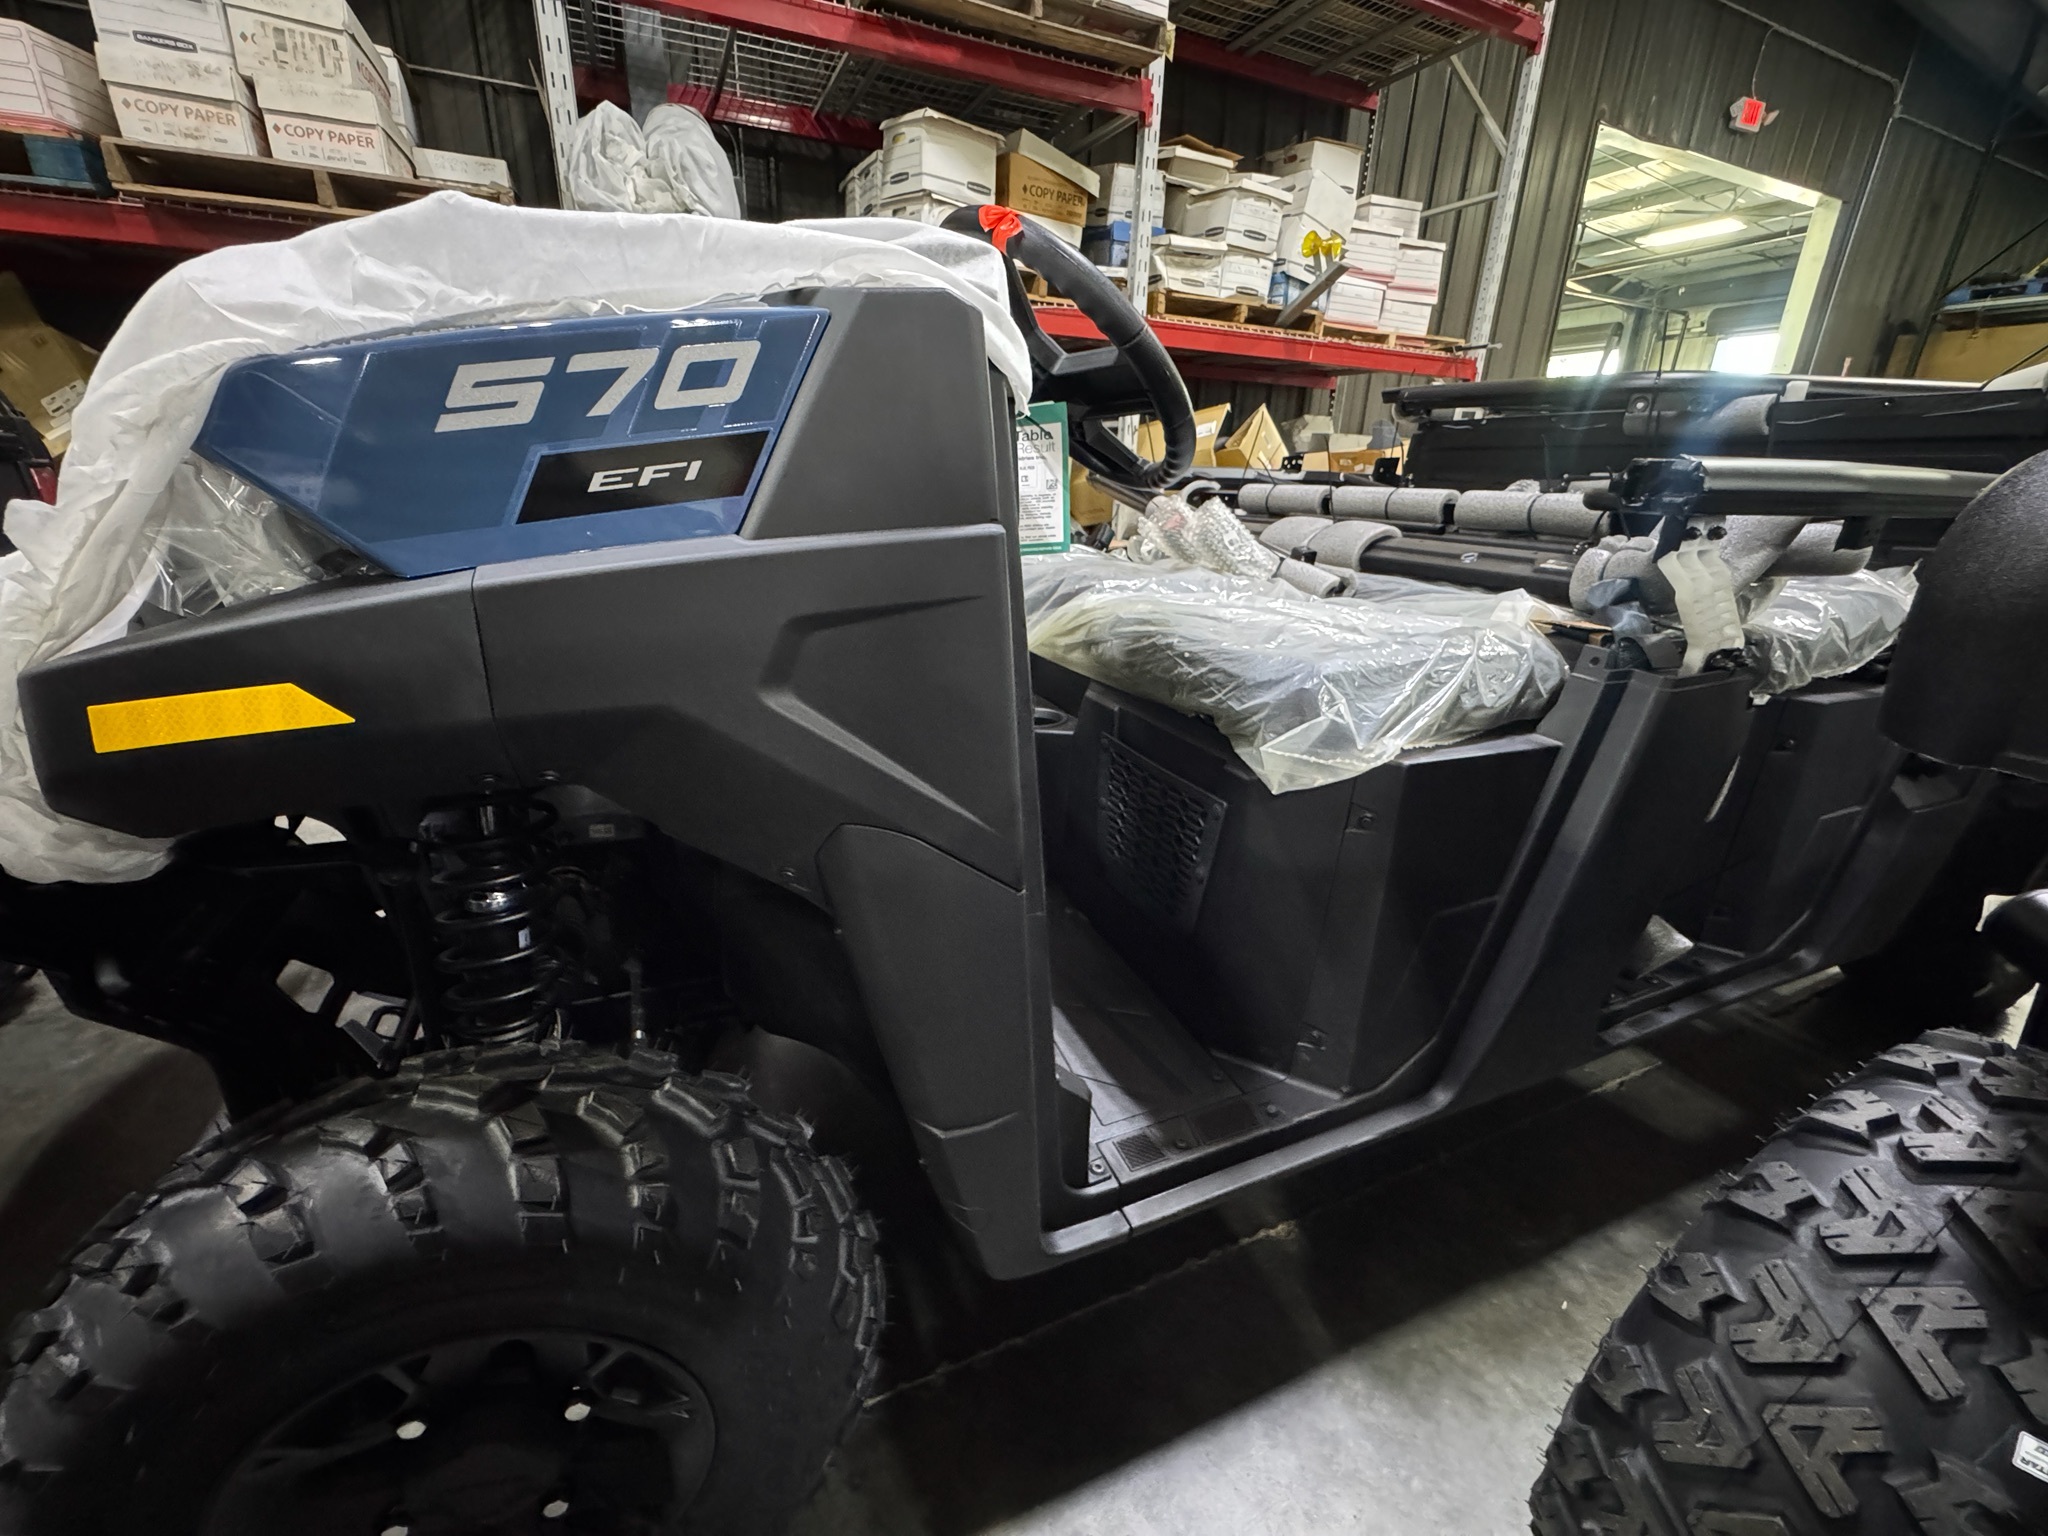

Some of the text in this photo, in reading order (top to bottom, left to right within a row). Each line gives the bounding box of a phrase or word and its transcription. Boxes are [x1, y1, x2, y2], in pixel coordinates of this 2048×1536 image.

[133, 98, 237, 127] COPY PAPER
[284, 123, 376, 150] COPY PAPER
[1029, 184, 1085, 207] COPY PAPER
[587, 460, 702, 493] EFI
